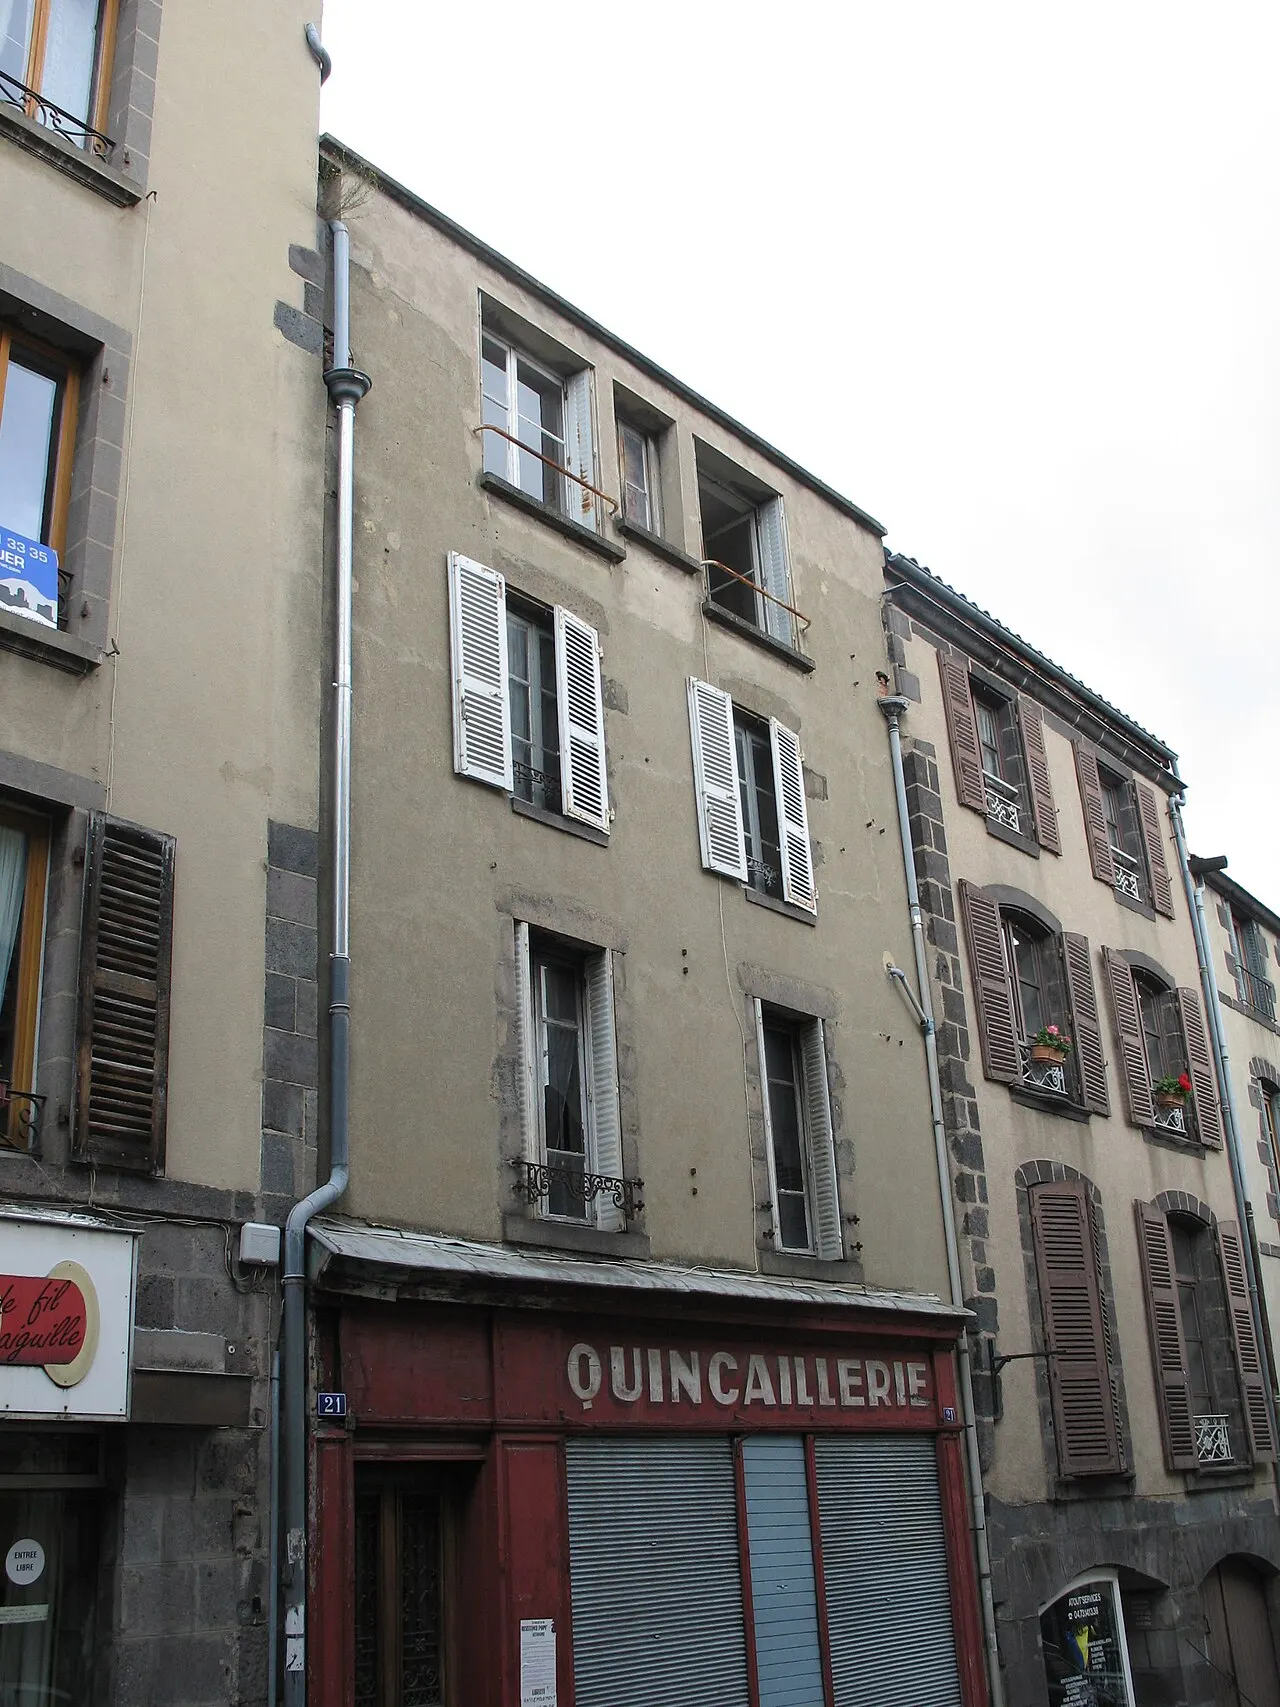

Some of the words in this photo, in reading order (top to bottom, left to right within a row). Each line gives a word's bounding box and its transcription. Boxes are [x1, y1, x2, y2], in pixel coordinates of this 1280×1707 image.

[7, 537, 26, 554] 33
[29, 547, 48, 563] 35
[27, 1280, 72, 1325] fil
[567, 1342, 930, 1410] QUINCAILLERIE
[324, 1396, 341, 1413] 21
[16, 1563, 34, 1571] LIBRE
